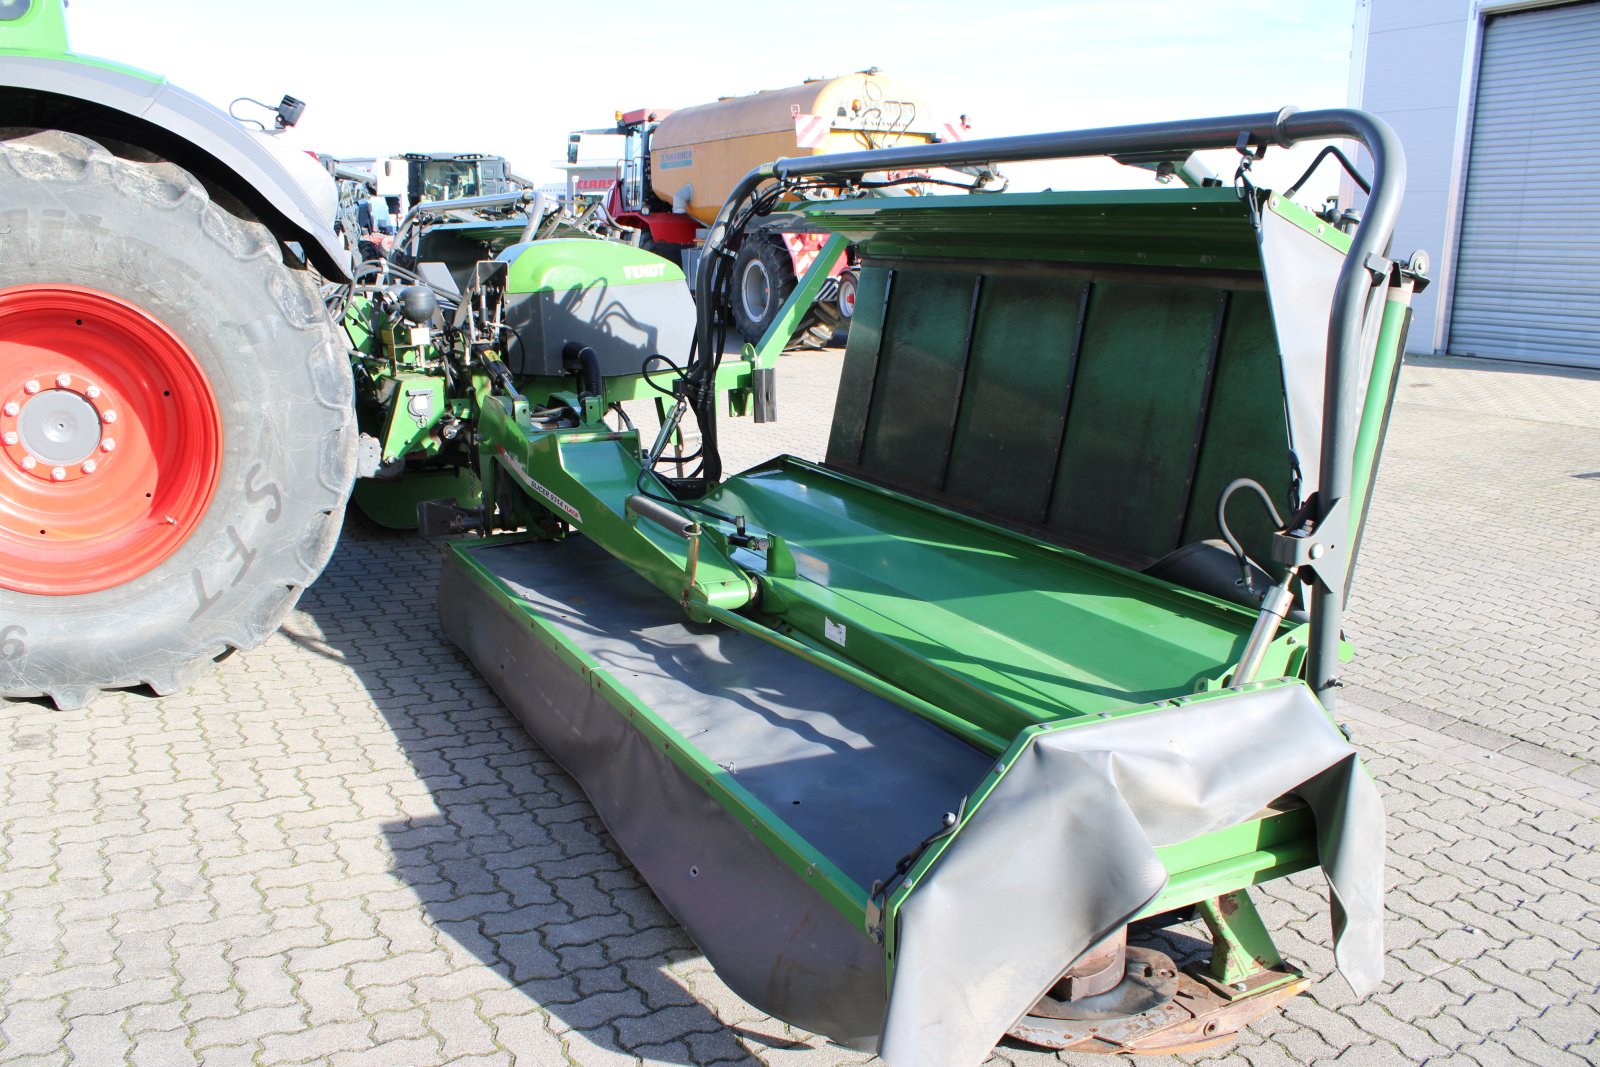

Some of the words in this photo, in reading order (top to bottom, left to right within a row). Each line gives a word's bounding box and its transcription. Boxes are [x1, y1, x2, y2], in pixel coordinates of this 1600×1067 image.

[576, 179, 615, 189] CLAAS
[623, 263, 666, 280] FENDT
[531, 481, 549, 497] SLICER
